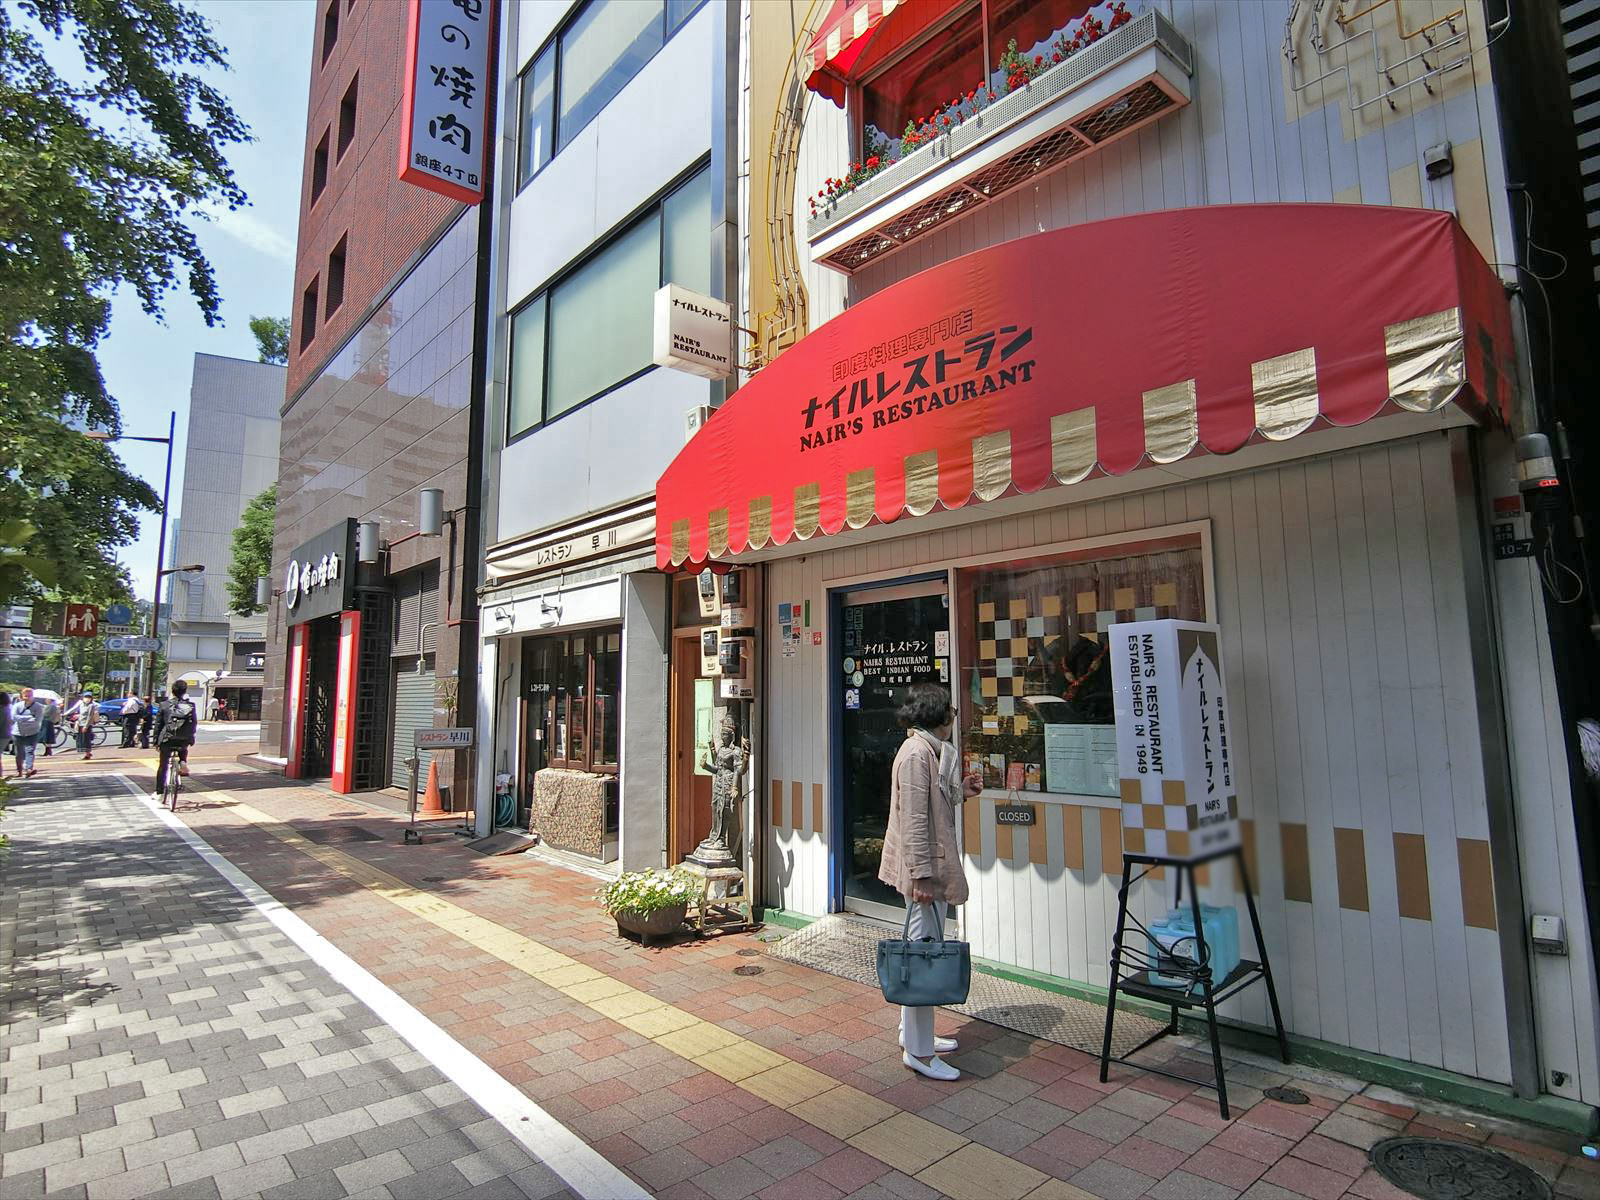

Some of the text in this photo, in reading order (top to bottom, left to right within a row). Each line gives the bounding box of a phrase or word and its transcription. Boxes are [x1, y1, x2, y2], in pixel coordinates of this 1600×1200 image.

[415, 153, 478, 186] 銀座4丁目
[672, 298, 729, 323] ナイルレストラン
[673, 333, 701, 347] NAIR'S
[673, 341, 728, 363] RESTAURANT
[832, 309, 973, 382] 印度料理専門店
[801, 325, 1033, 430] ナイルレストラン
[800, 359, 1036, 452] NAIR'S RESTAURANT
[537, 544, 572, 565] レストラン
[863, 665, 931, 675] BEST INDIAN FOOD
[885, 655, 928, 666] RESTAURANT
[1128, 635, 1148, 775] ESTABLISHED IN 1949
[1141, 633, 1163, 775] NAIR'S RESTAURANT
[449, 731, 470, 743] 早川
[1196, 657, 1215, 794] ナイルレストラン
[998, 811, 1031, 822] CLOSED
